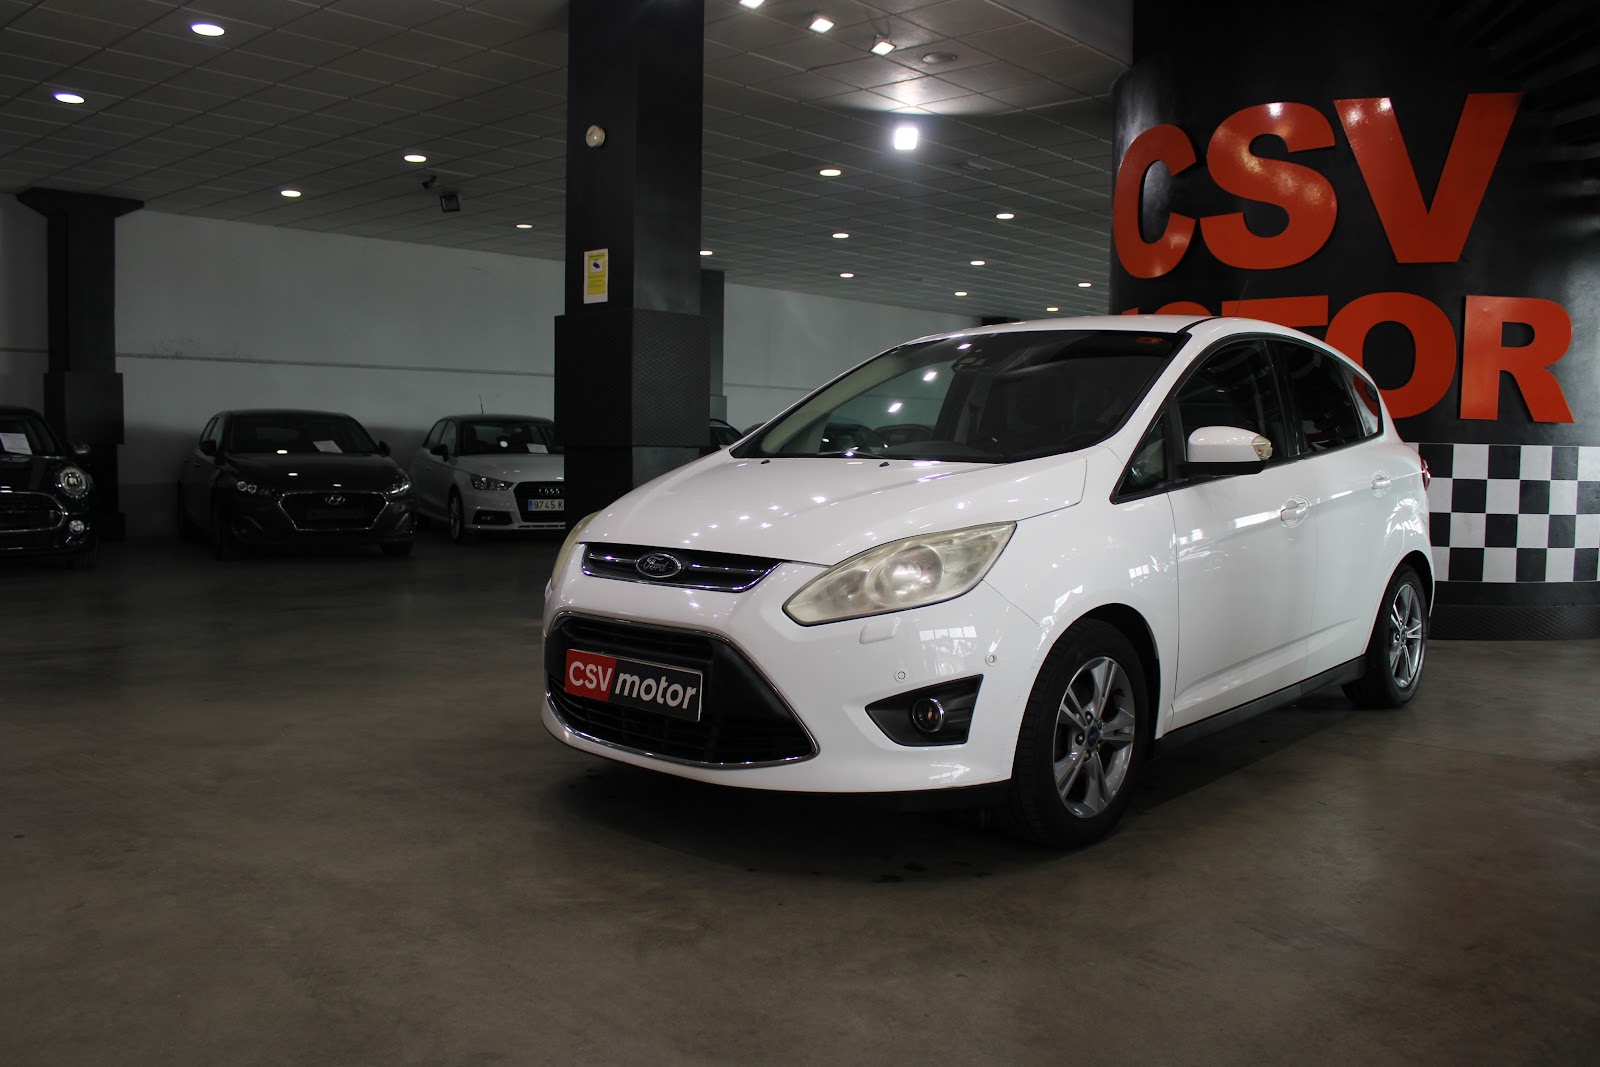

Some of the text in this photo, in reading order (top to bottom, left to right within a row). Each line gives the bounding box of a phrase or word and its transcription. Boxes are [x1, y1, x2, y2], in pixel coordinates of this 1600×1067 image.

[1113, 92, 1523, 279] CSV
[533, 500, 556, 510] 9745
[643, 556, 670, 572] Ford
[569, 660, 697, 710] CSV motor
